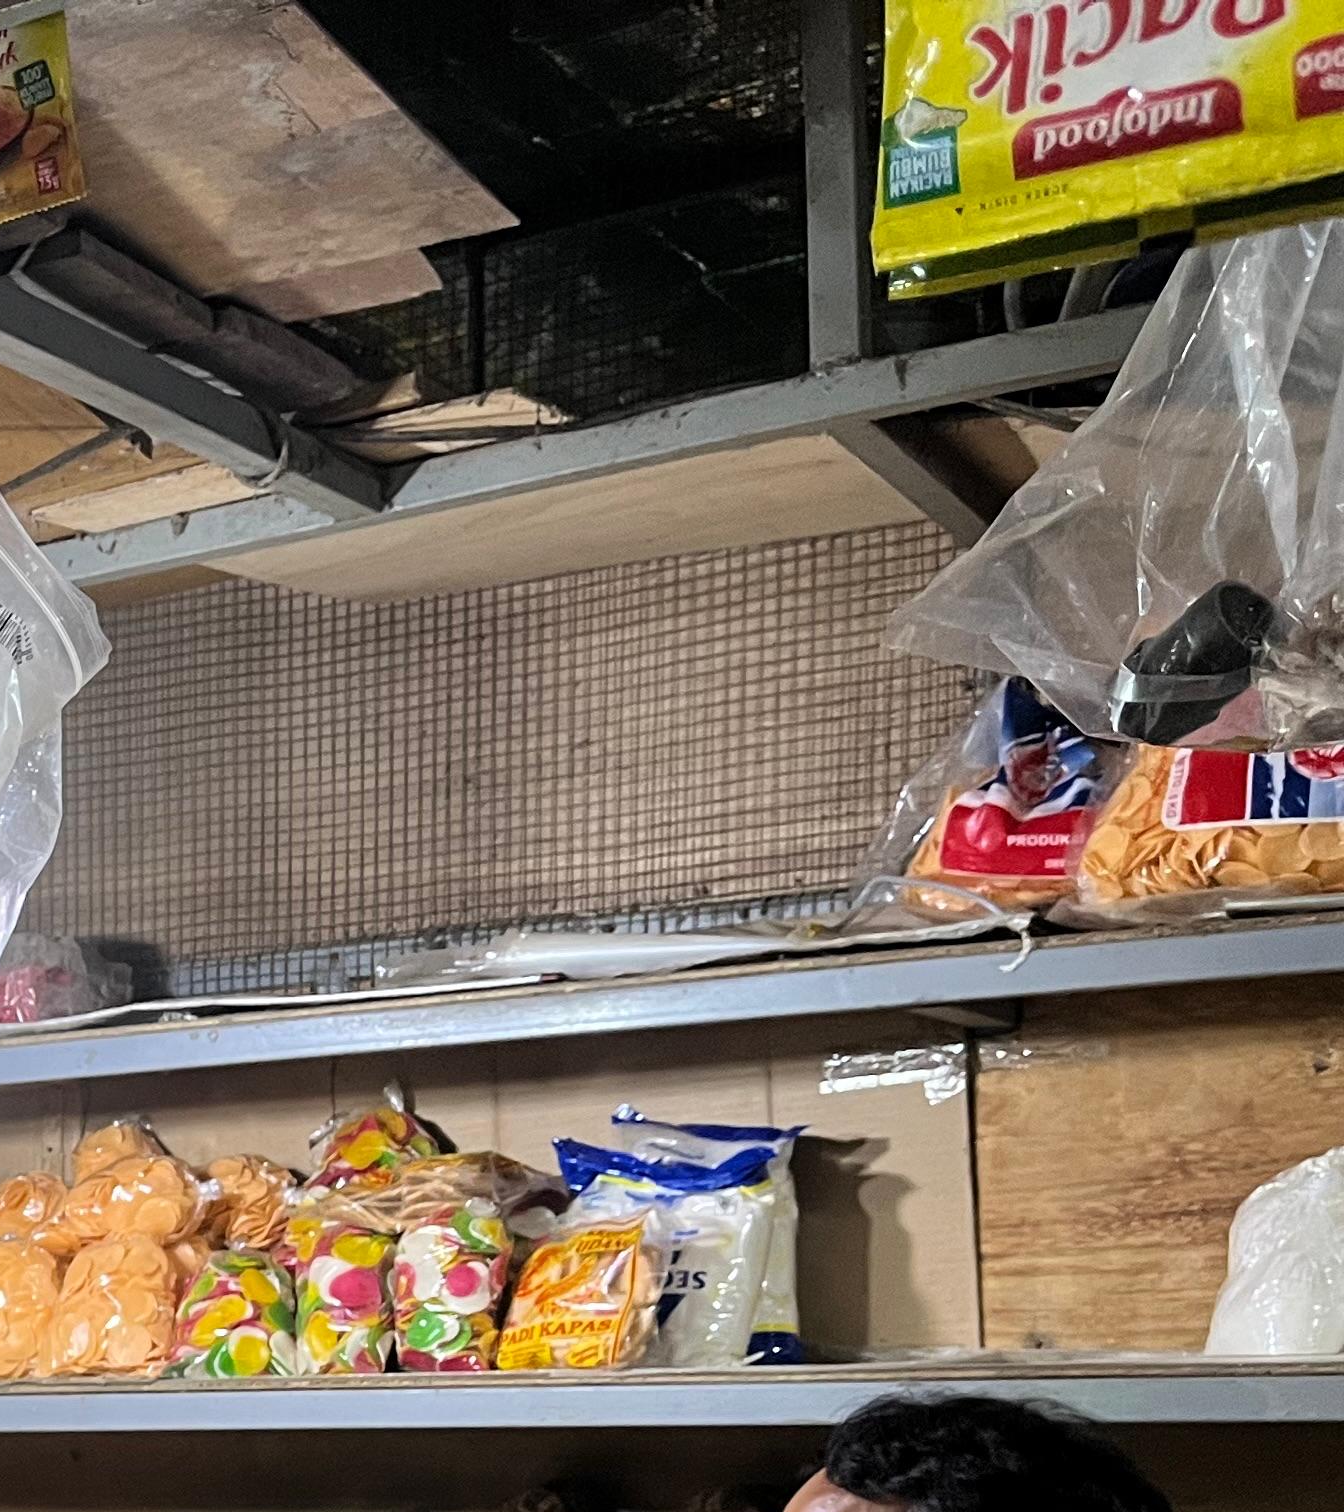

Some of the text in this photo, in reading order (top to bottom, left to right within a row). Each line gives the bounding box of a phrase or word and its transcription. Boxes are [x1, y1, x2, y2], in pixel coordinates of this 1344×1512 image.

[1031, 91, 1214, 162] Indofood
[889, 143, 952, 178] BUMBU
[540, 1319, 612, 1337] KAPAS
